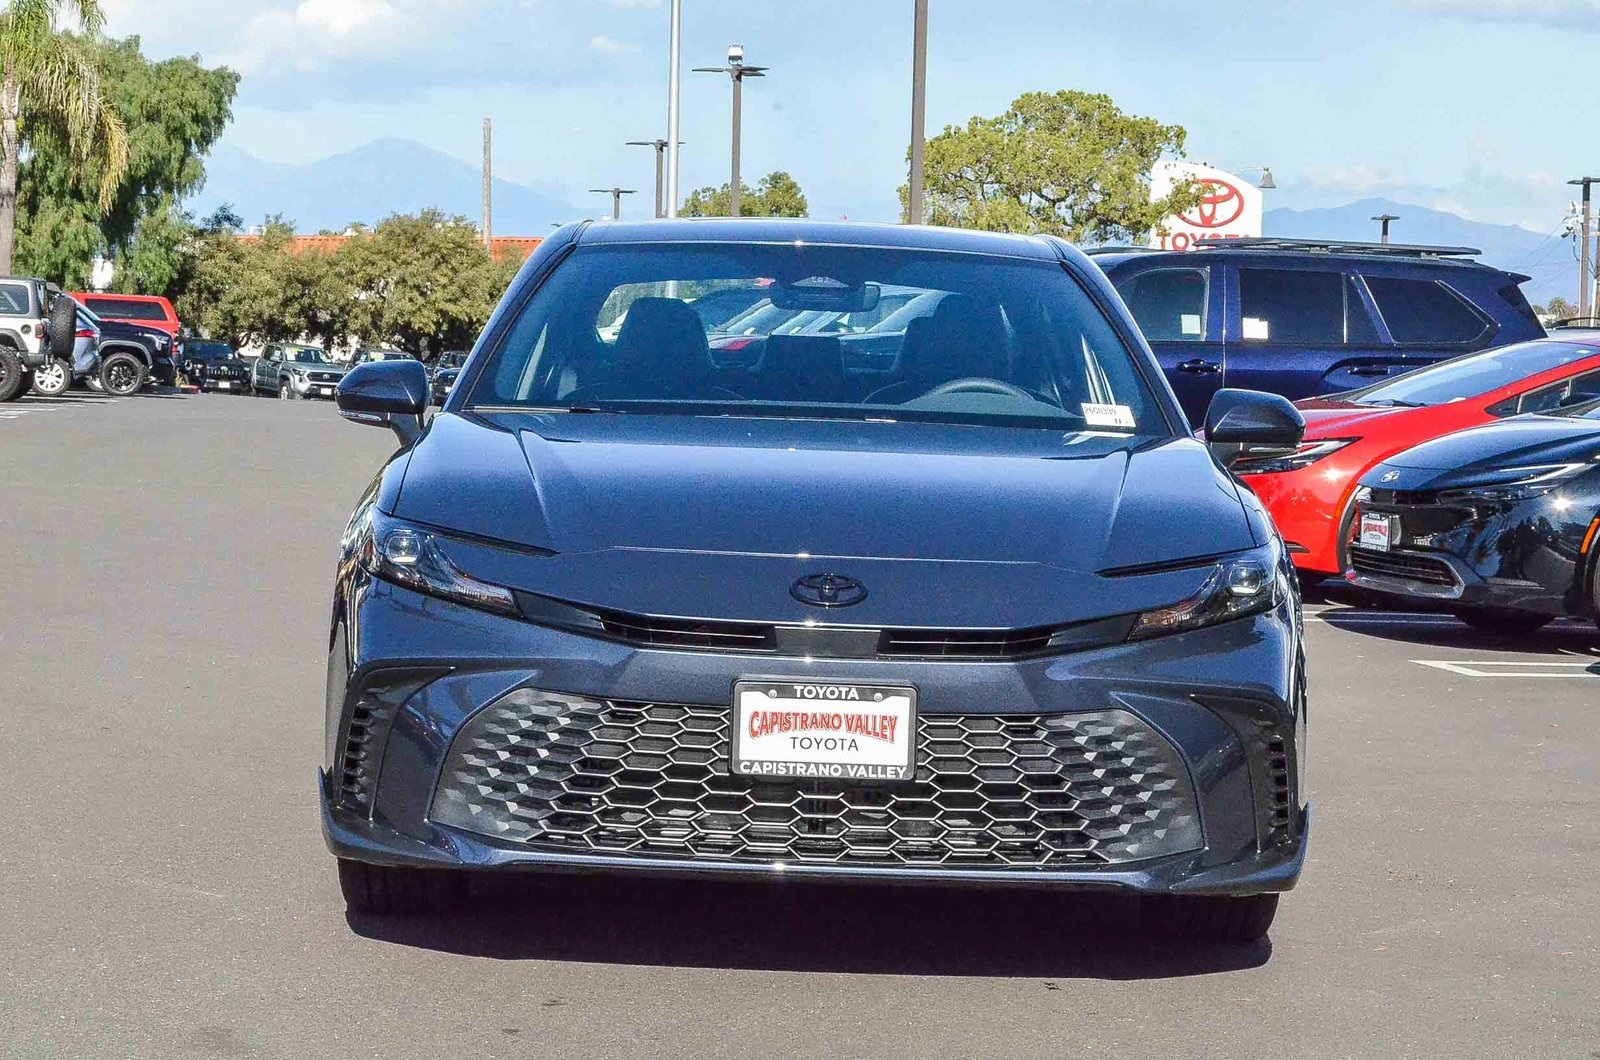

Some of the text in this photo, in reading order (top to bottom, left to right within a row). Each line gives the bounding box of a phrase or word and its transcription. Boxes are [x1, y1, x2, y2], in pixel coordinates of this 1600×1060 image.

[1157, 231, 1250, 251] TOY
[793, 685, 860, 700] TOYOTA
[749, 710, 898, 744] CAPISTRANO VALLEY
[789, 736, 859, 751] TOYOTA
[739, 761, 907, 779] CAPISTRANO VALLEY
